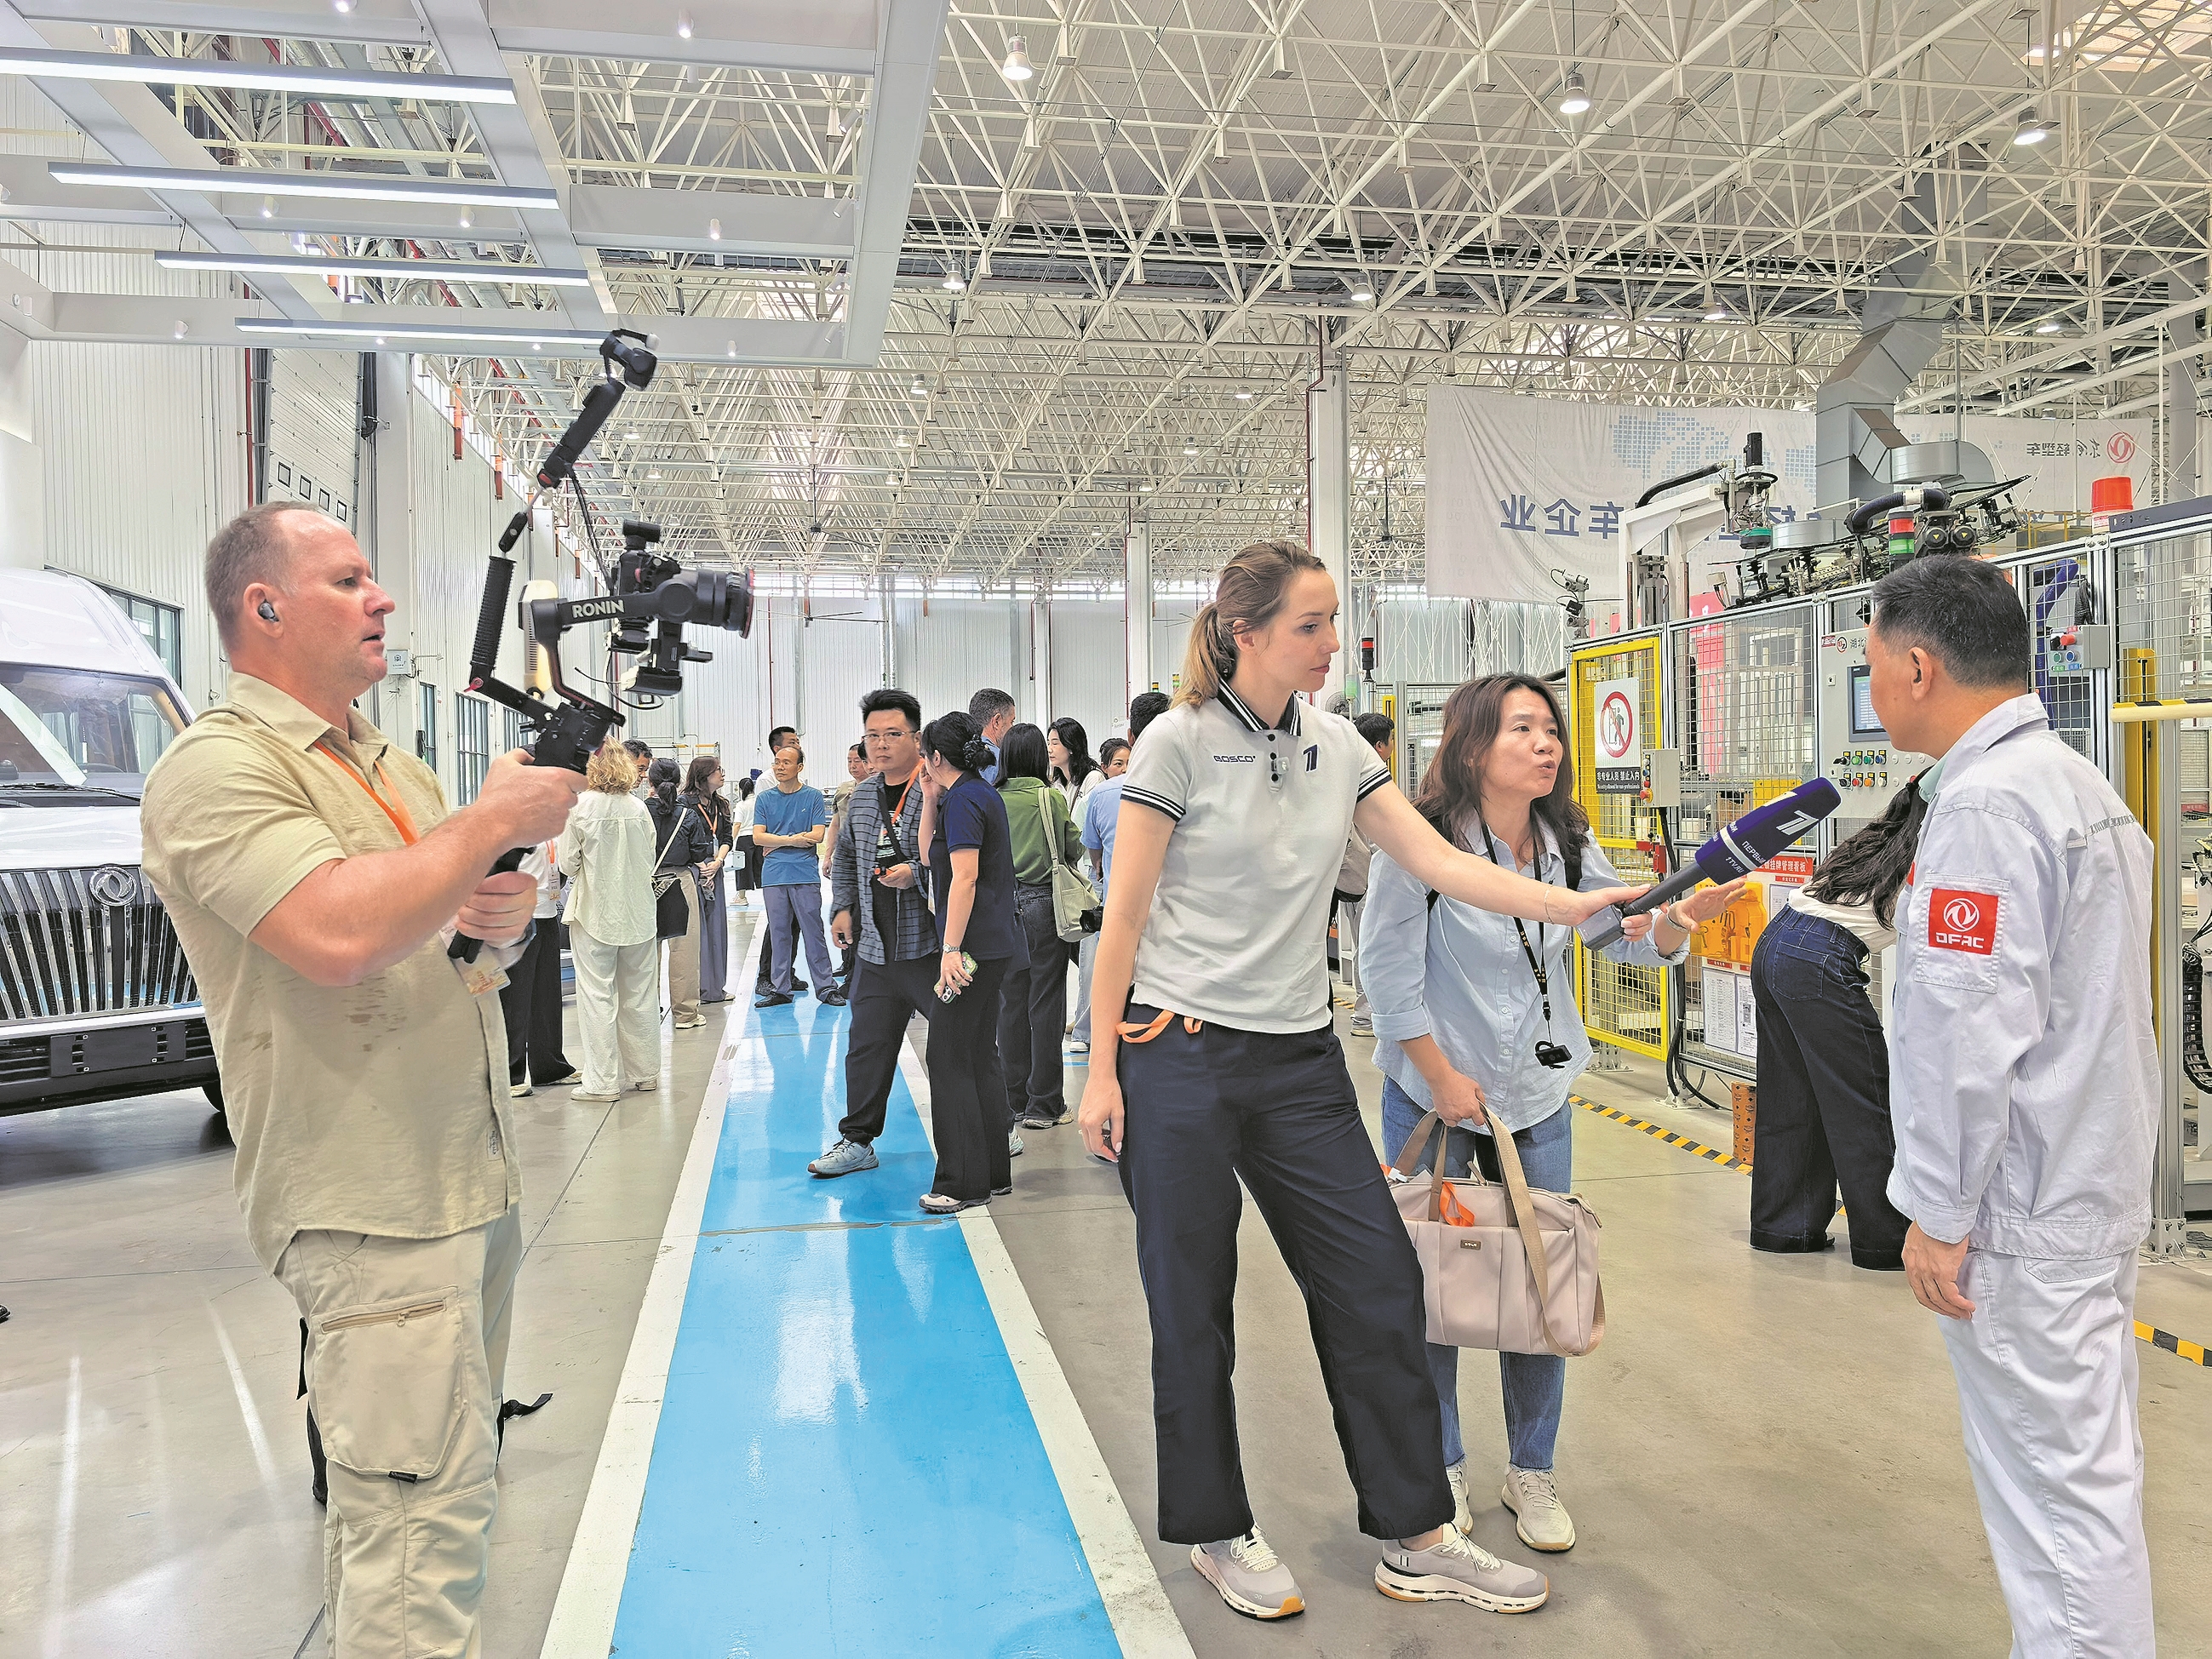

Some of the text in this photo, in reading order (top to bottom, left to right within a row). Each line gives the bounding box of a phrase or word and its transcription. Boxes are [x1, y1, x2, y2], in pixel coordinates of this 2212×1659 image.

[572, 599, 625, 619] RONIN
[1849, 637, 1868, 649] 湖北
[1725, 856, 1745, 873] 1TV.RU
[1758, 859, 1806, 872] 锁挂牌管理看板
[1935, 932, 1985, 949] DFAC
